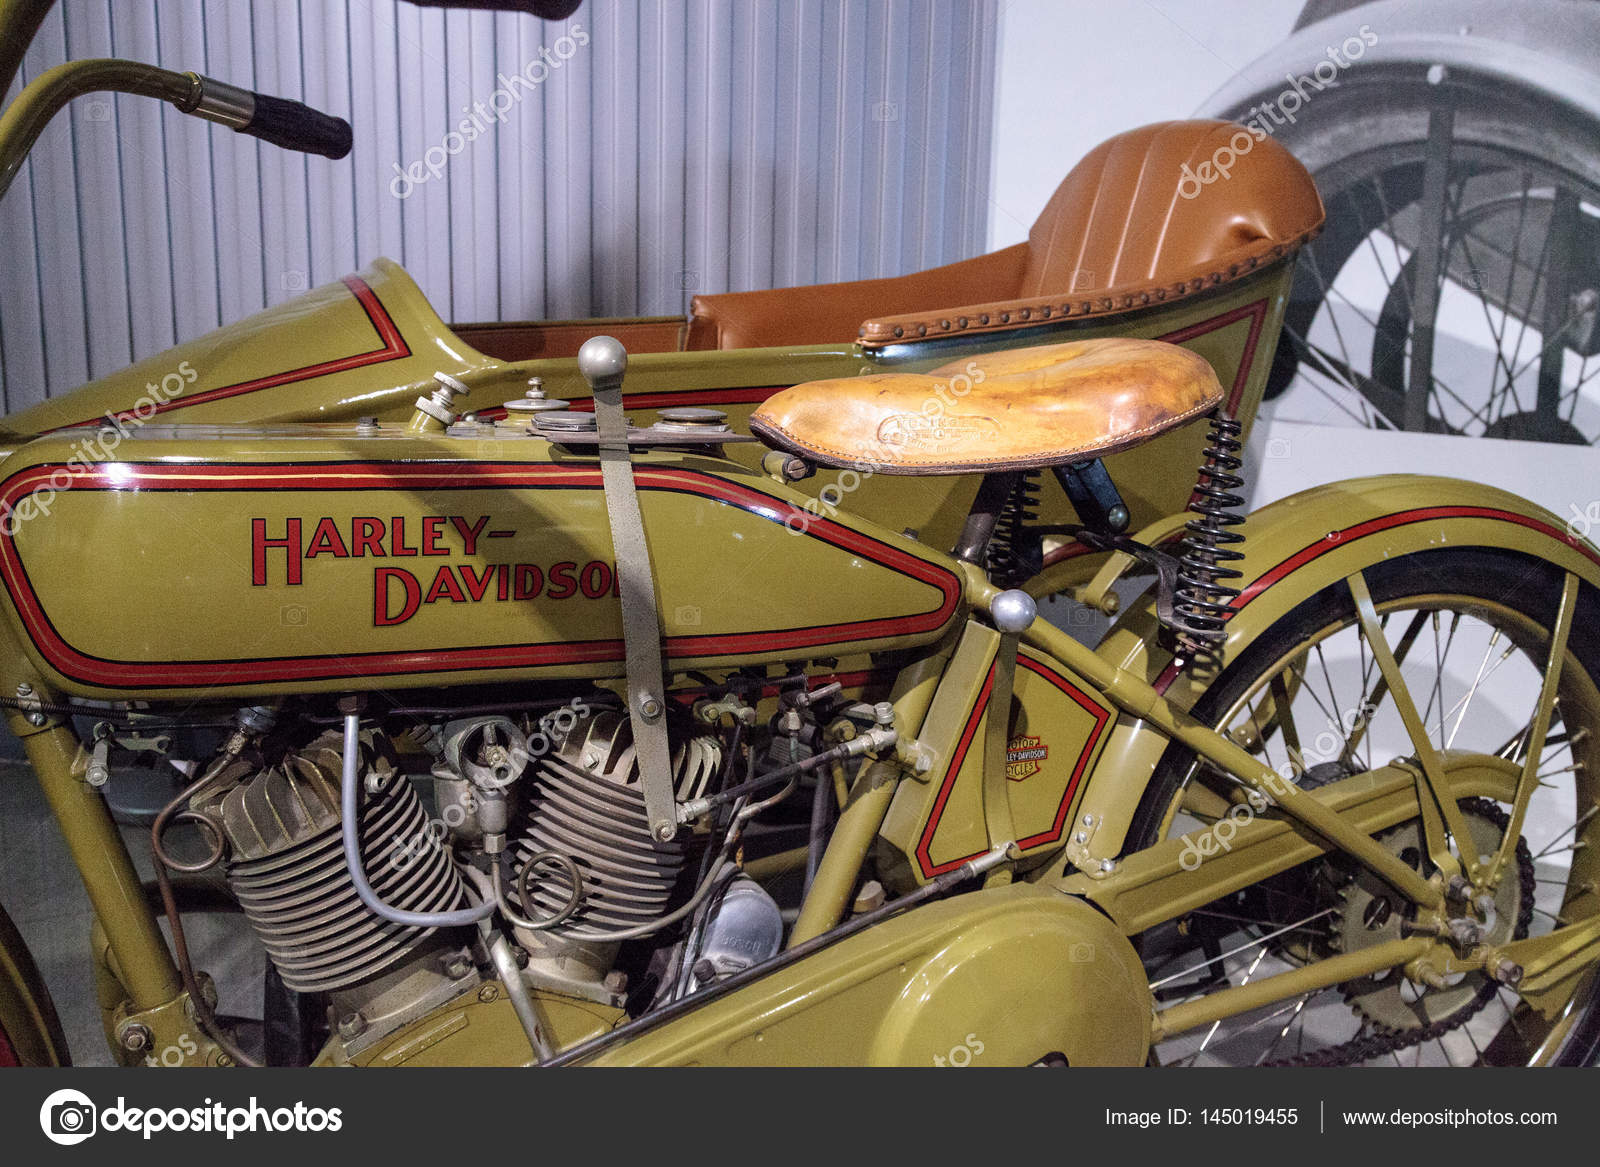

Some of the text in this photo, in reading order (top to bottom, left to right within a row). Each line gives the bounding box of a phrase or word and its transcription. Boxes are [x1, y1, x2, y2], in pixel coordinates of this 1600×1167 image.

[373, 561, 621, 627] DAVIDSO
[1007, 738, 1035, 749] OTOR
[1007, 749, 1045, 762] LEY-DAVIDSON
